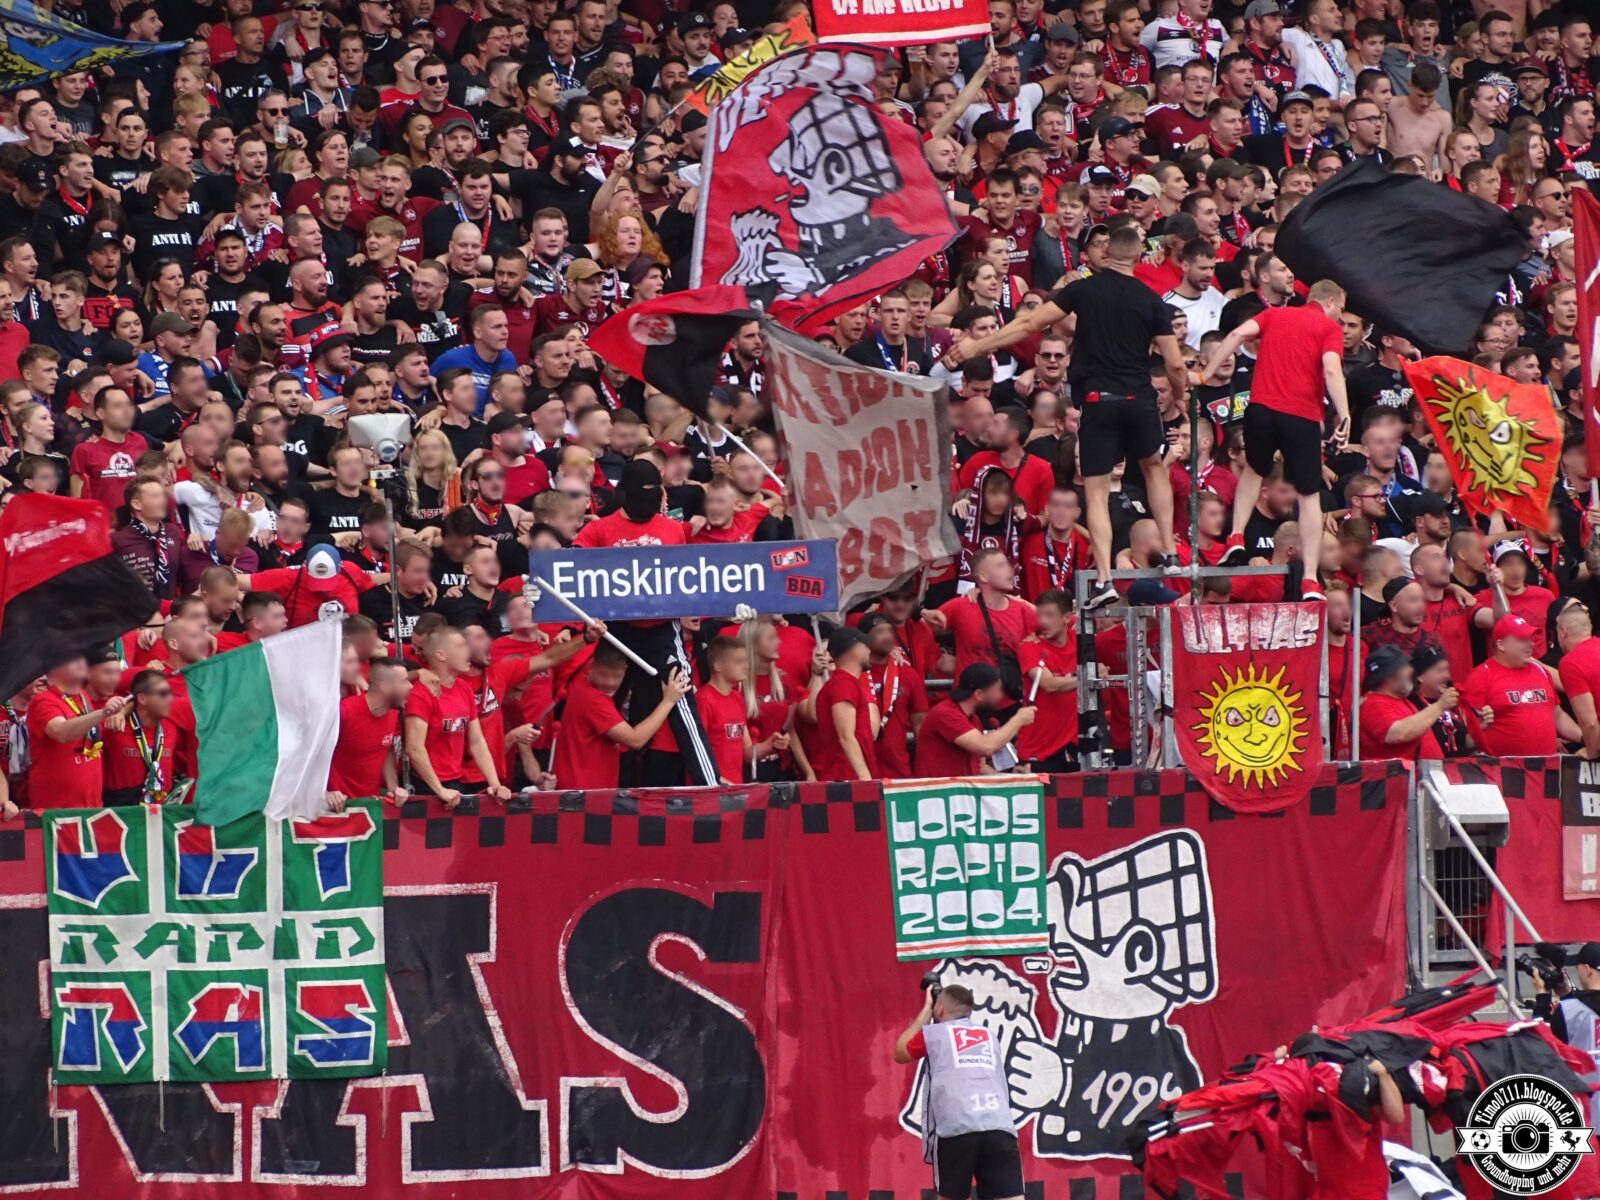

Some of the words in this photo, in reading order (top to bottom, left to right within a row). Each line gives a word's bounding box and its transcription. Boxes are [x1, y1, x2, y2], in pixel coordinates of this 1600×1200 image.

[152, 233, 180, 246] ANTI
[328, 515, 360, 528] ANTI
[552, 556, 765, 599] Emskirchen
[787, 577, 822, 595] BDA
[1177, 603, 1320, 653] ULTRAS
[890, 793, 1040, 843] LORDS
[894, 841, 1041, 890] RAPiD
[898, 887, 1043, 935] 2004
[58, 916, 376, 966] RAPID
[55, 979, 377, 1074] RAS
[970, 1092, 1000, 1112] 18
